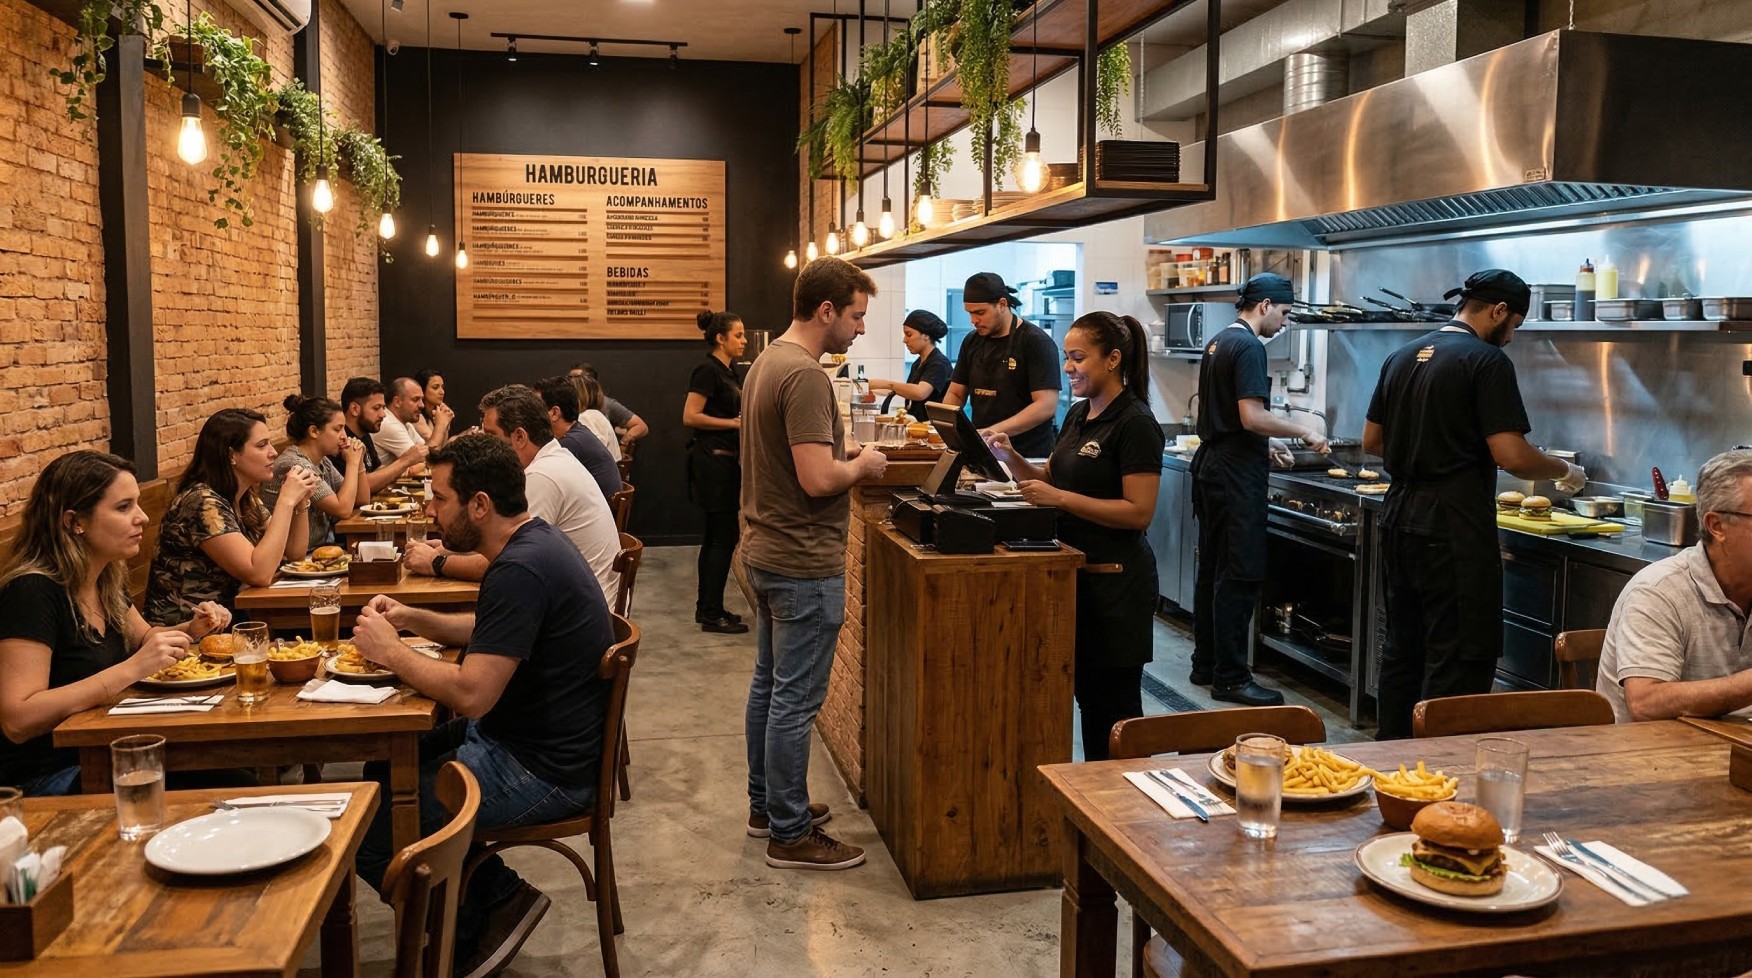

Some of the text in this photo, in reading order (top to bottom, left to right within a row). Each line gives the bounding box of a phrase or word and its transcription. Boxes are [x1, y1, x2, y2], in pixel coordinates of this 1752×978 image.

[525, 164, 658, 186] HAMBURGUERIA
[472, 190, 555, 205] HAMBÚRGUERES
[606, 196, 708, 209] ACOMPANHAMENTOS
[607, 267, 649, 278] BEBIDAS
